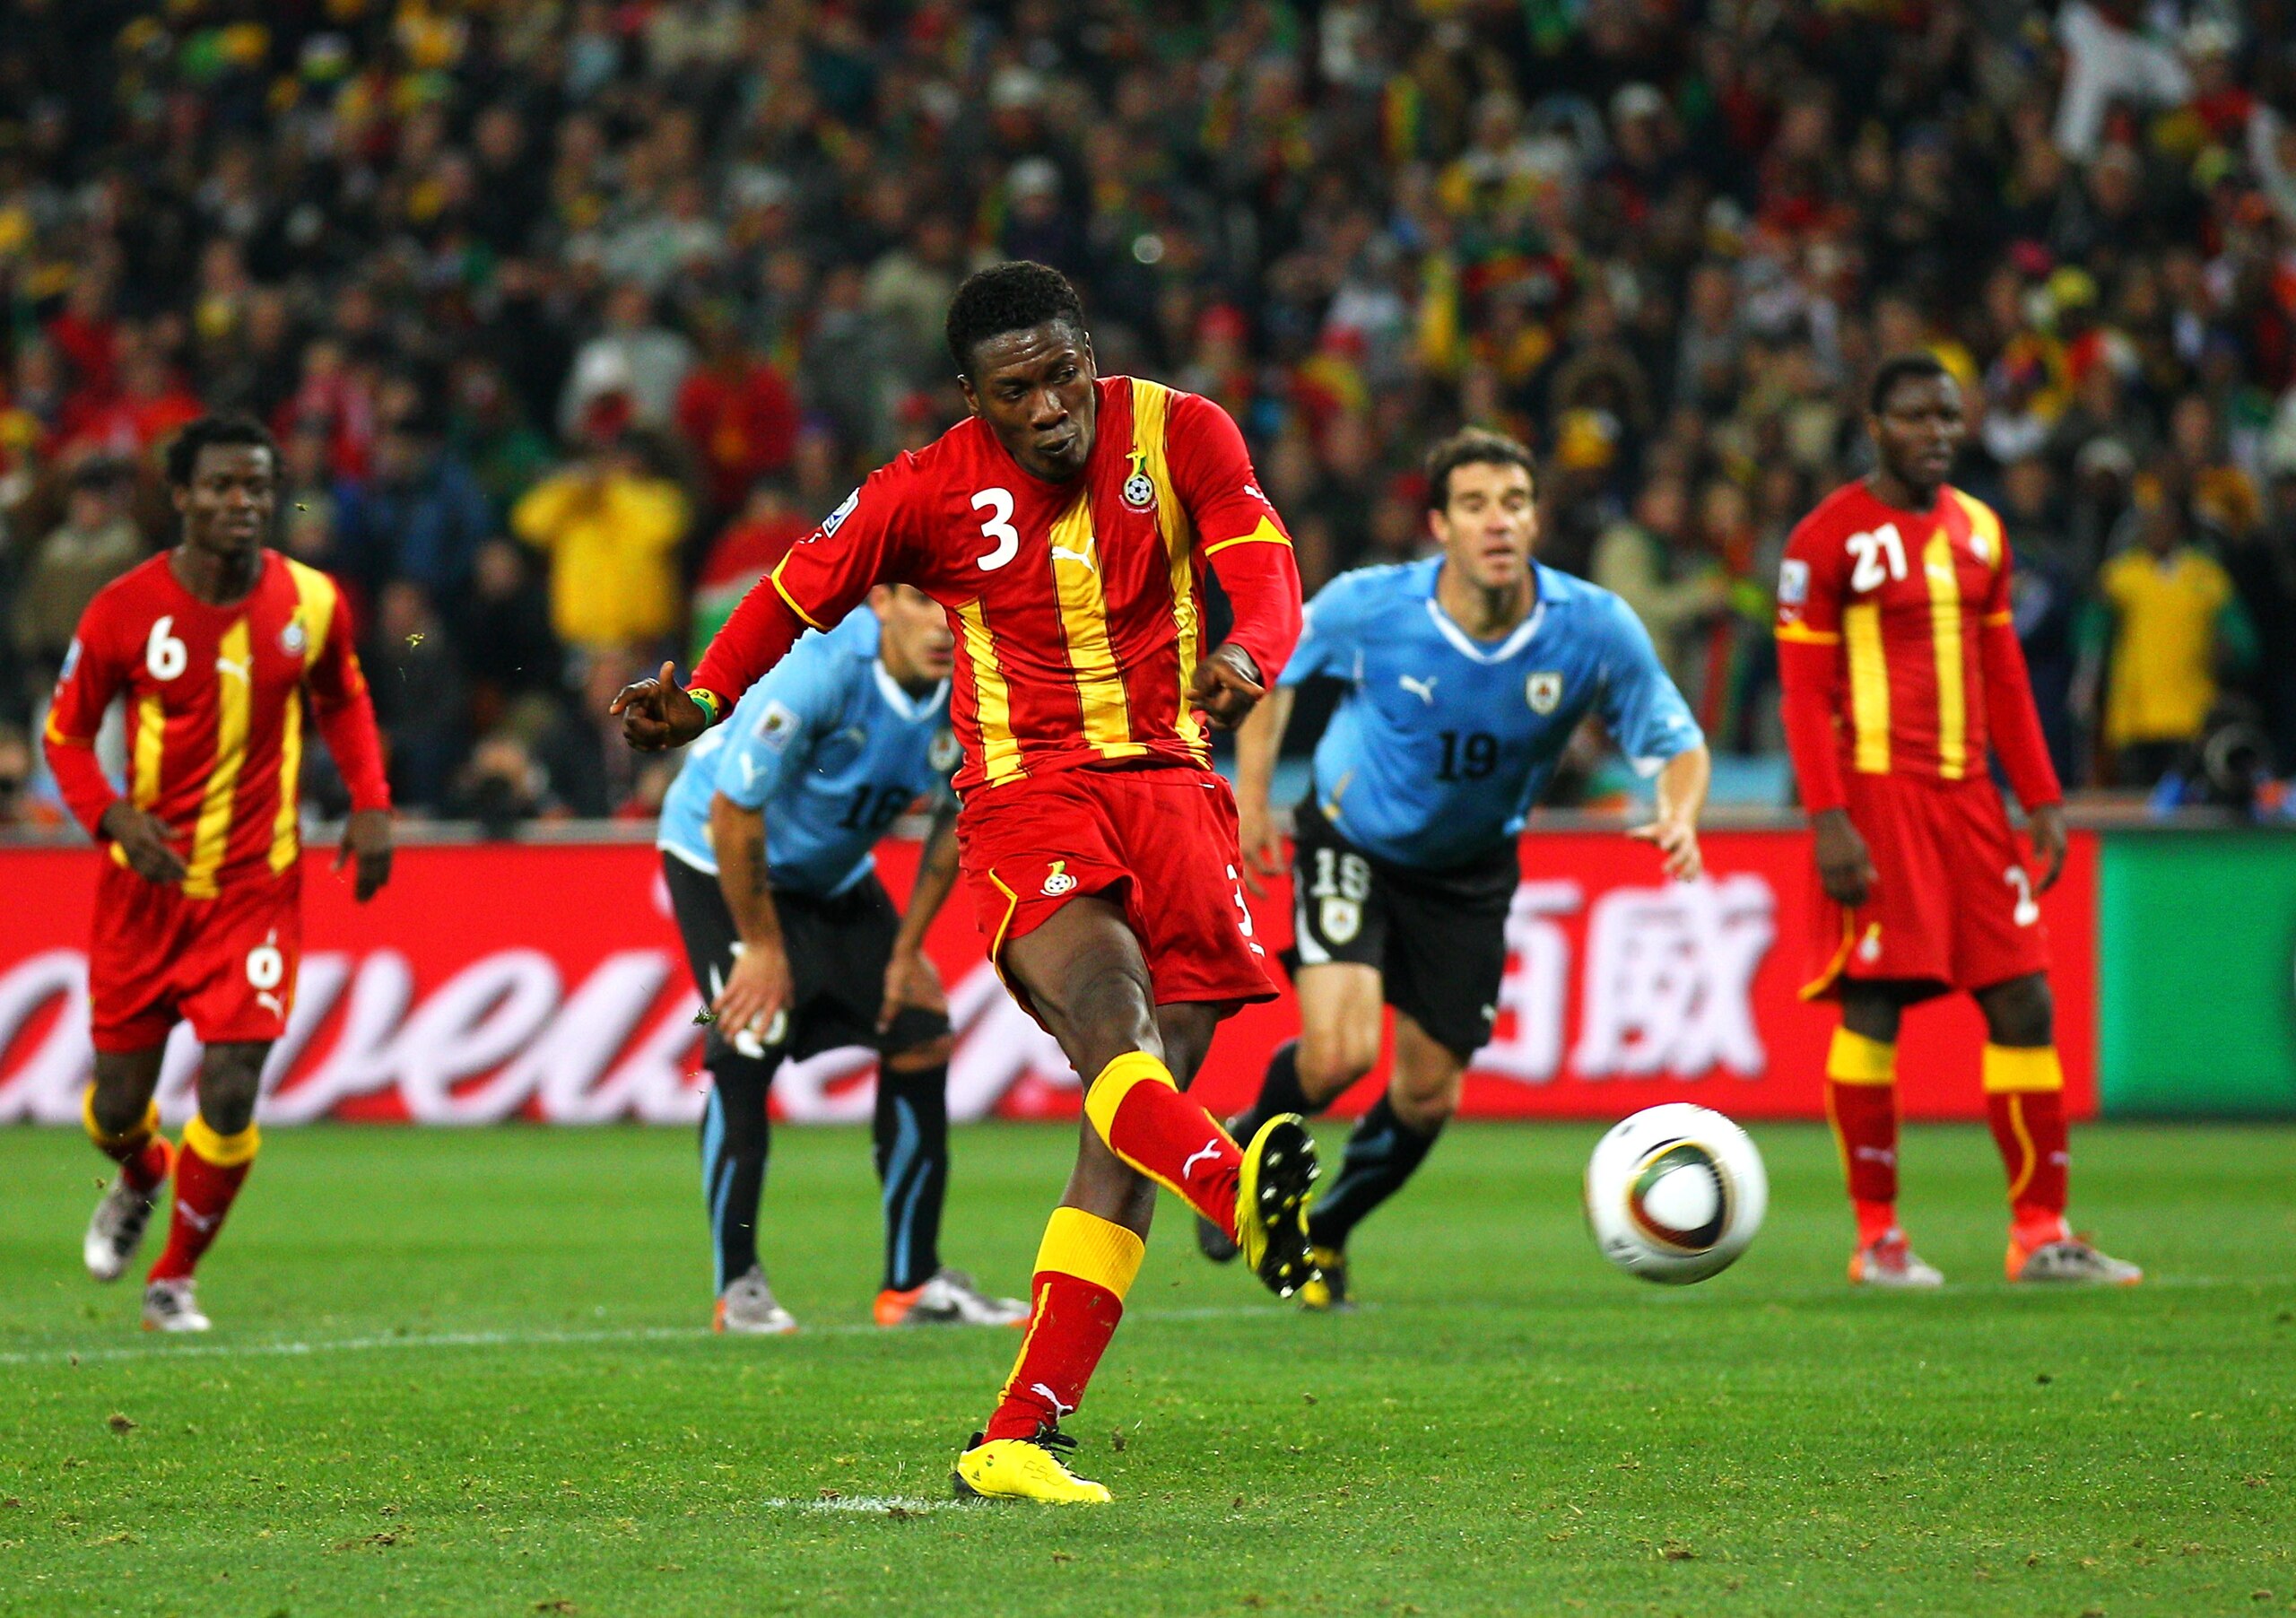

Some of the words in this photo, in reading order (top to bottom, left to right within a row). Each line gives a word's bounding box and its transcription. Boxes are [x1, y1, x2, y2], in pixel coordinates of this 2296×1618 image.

[970, 487, 1020, 571] 3
[1845, 523, 1908, 593] 21
[146, 615, 187, 682] 6
[1436, 731, 1497, 780] 19
[837, 784, 910, 831] 16
[246, 927, 283, 990] 6
